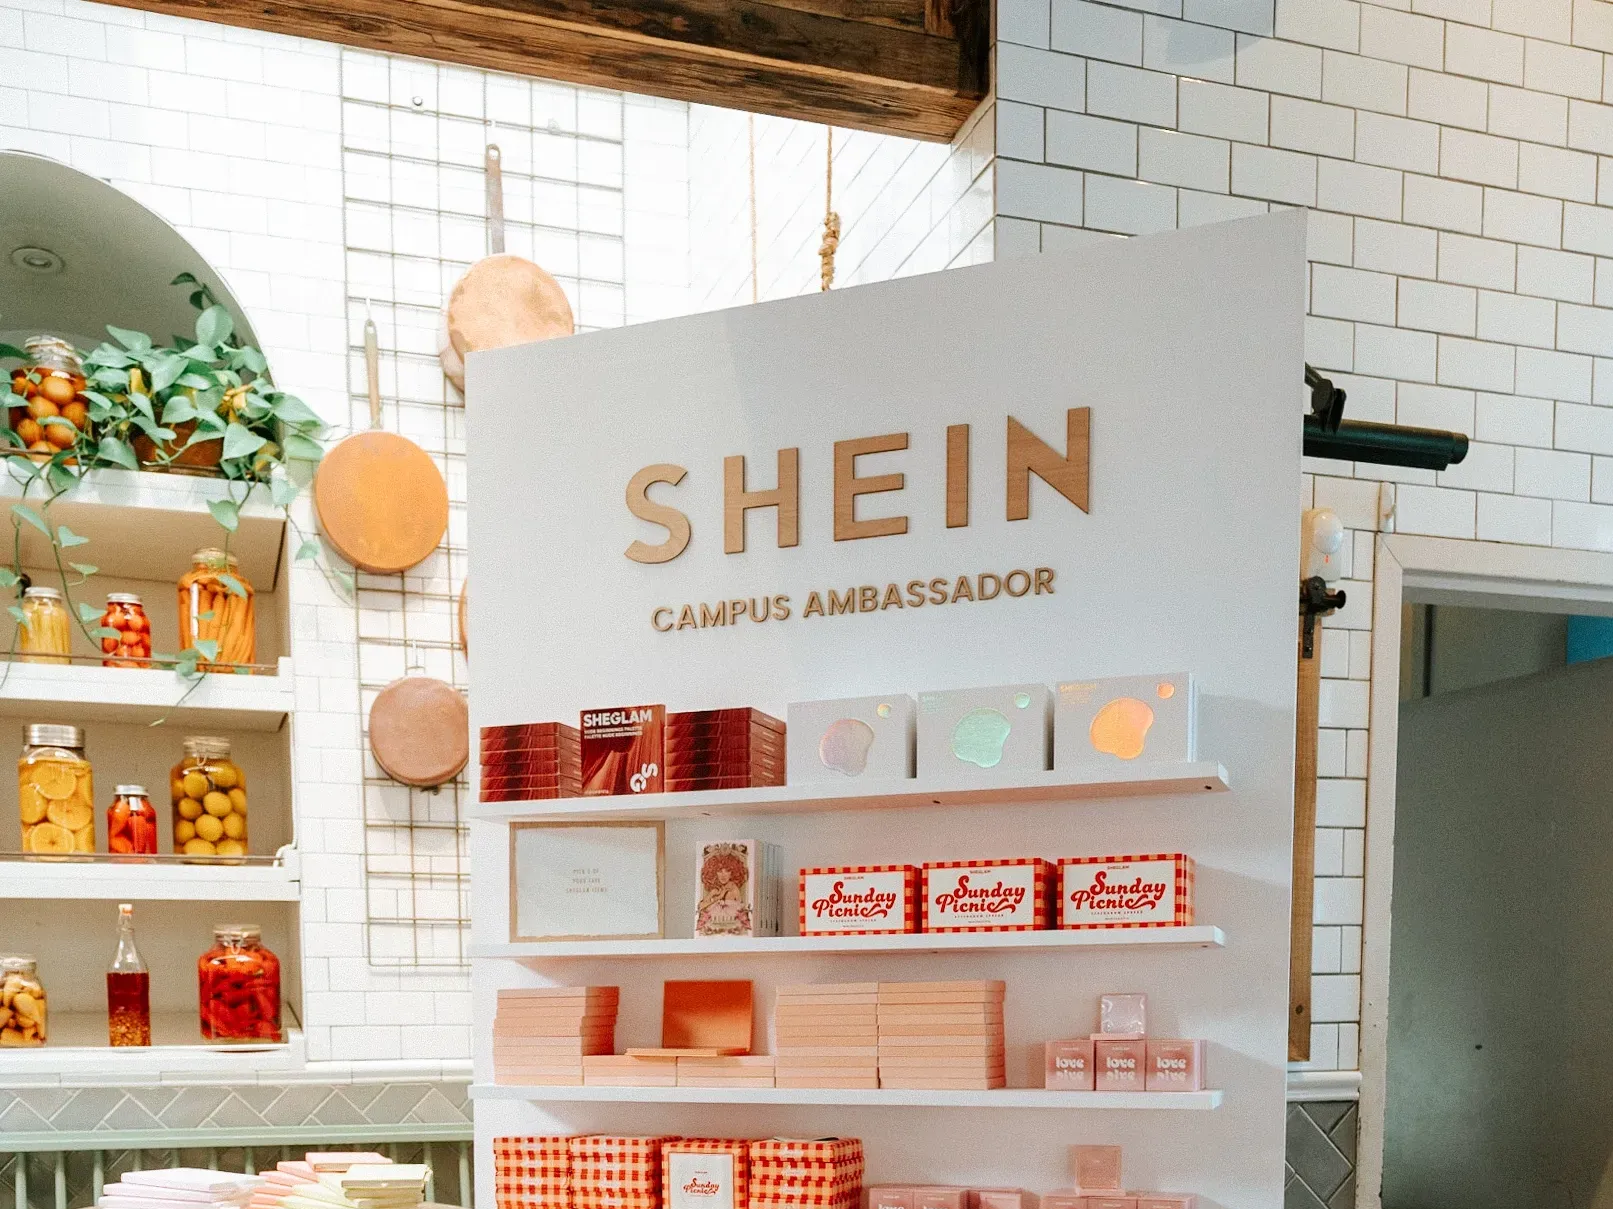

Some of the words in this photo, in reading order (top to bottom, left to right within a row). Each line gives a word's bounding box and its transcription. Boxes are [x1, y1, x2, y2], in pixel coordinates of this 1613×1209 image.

[624, 406, 1091, 565] SHEIN
[651, 594, 791, 632] CAMPUS
[803, 566, 1056, 618] AMBASSADOR
[583, 709, 653, 728] SHEGLAM
[829, 881, 897, 909] Sunday
[953, 875, 1026, 904] Sunday
[1090, 870, 1166, 901] Sunday
[812, 898, 888, 918] Picnic
[935, 893, 1016, 914] Picnic
[1070, 890, 1157, 910] Picnic
[683, 1184, 716, 1195] Picnic
[691, 1177, 720, 1191] Sunday
